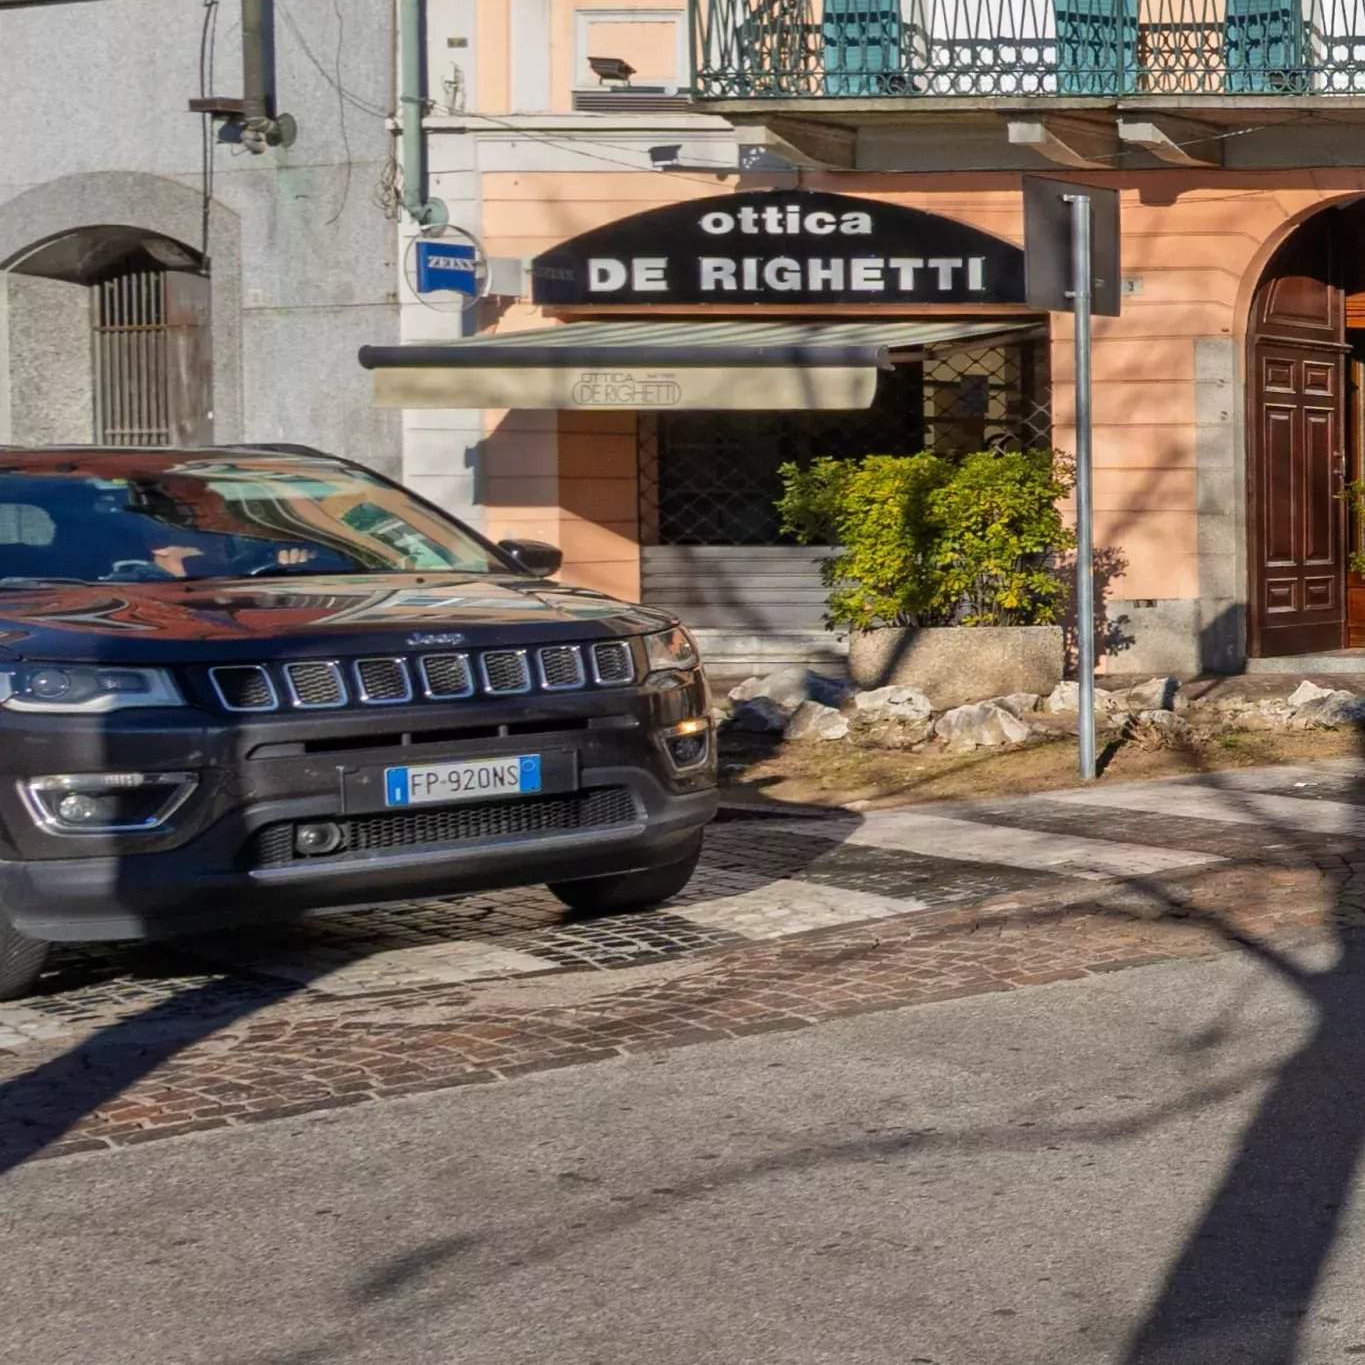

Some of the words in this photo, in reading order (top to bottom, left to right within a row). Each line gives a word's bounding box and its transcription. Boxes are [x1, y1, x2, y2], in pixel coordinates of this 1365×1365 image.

[700, 206, 873, 235] ottica
[427, 255, 475, 272] ZEISS
[588, 257, 669, 292] DE
[700, 256, 986, 292] RIGHETTI
[406, 632, 465, 645] Jeep
